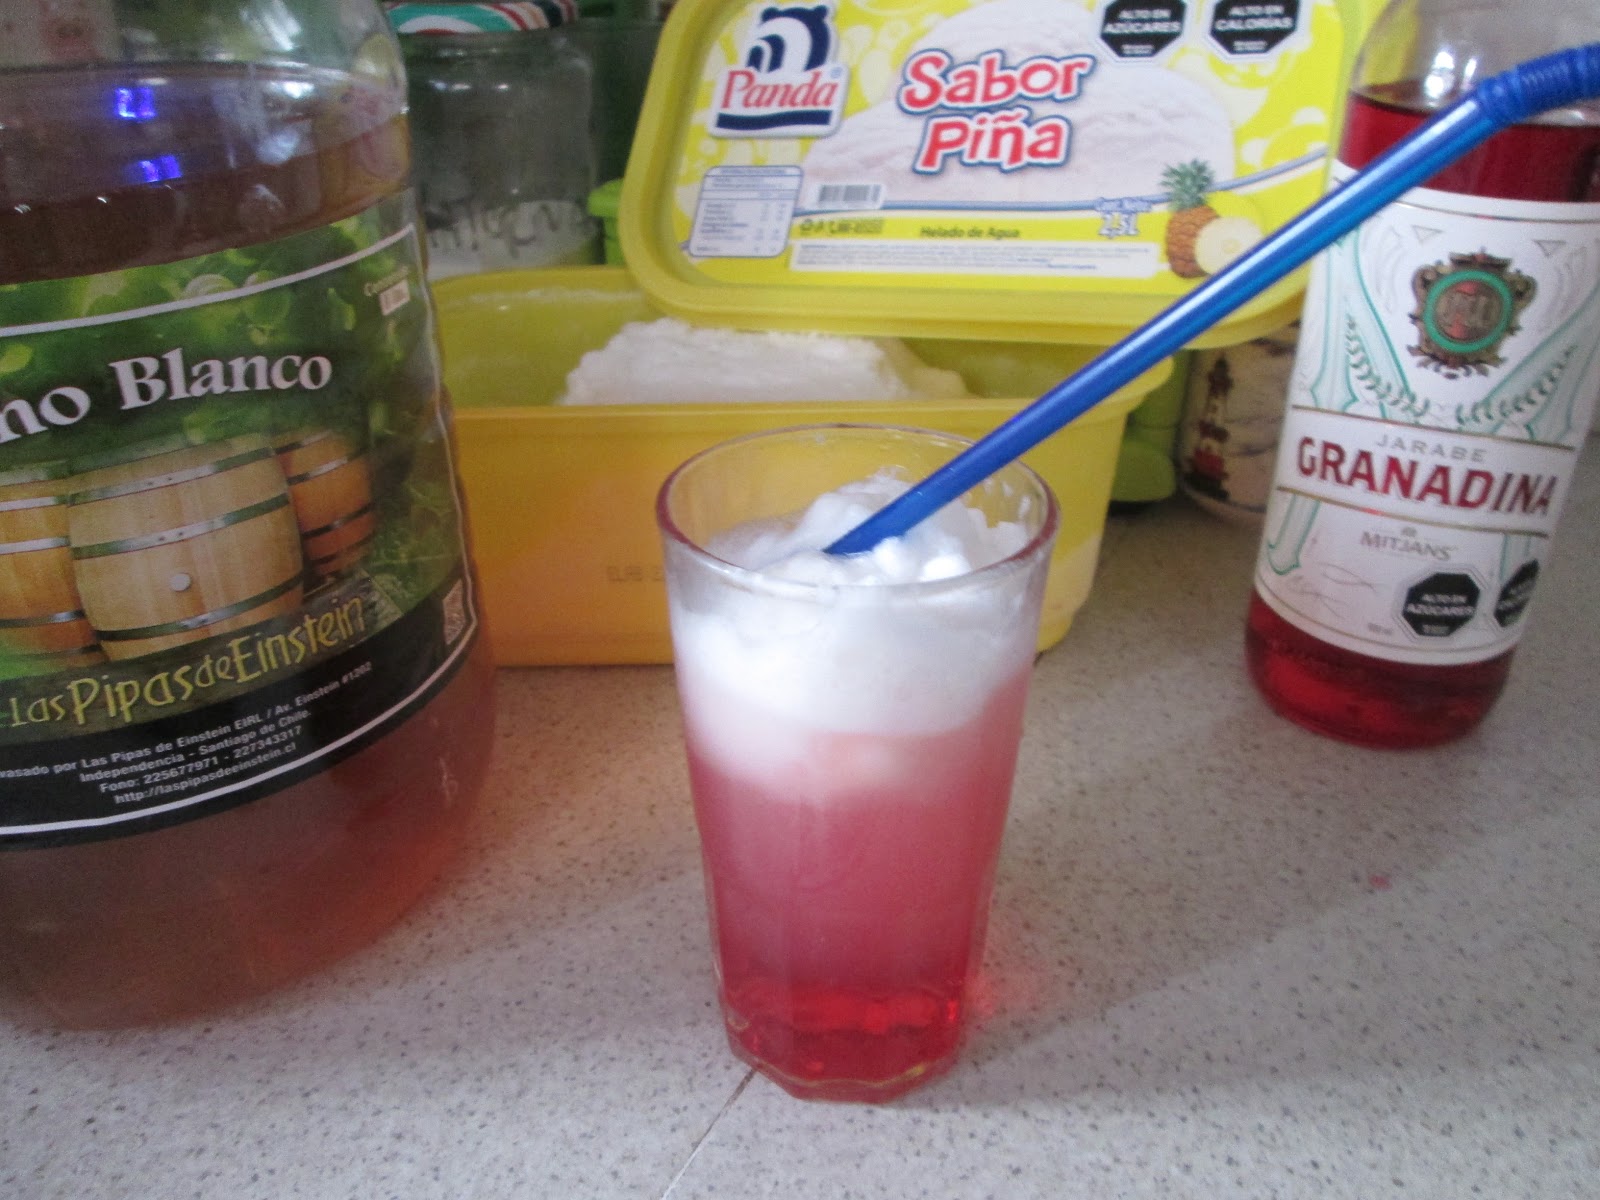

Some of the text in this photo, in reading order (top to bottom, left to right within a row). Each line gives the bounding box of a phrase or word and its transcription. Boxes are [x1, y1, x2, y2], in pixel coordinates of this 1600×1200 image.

[720, 69, 839, 109] Panda
[902, 52, 1090, 110] Sabor
[919, 110, 1066, 169] Piña
[109, 348, 332, 410] Blanco
[1376, 434, 1487, 463] JARABE
[9, 696, 66, 727] Las
[66, 664, 193, 726] Pipas
[228, 597, 366, 684] Einstein
[53, 761, 77, 775] por
[80, 757, 108, 769] Las
[110, 747, 152, 764] Pipas
[155, 741, 173, 752] de
[176, 724, 232, 747] Einstein
[234, 712, 263, 729] EIRL
[79, 753, 186, 783] Independencia
[198, 730, 257, 756] Santiago
[259, 721, 276, 736] de
[100, 777, 140, 793] Fono:
